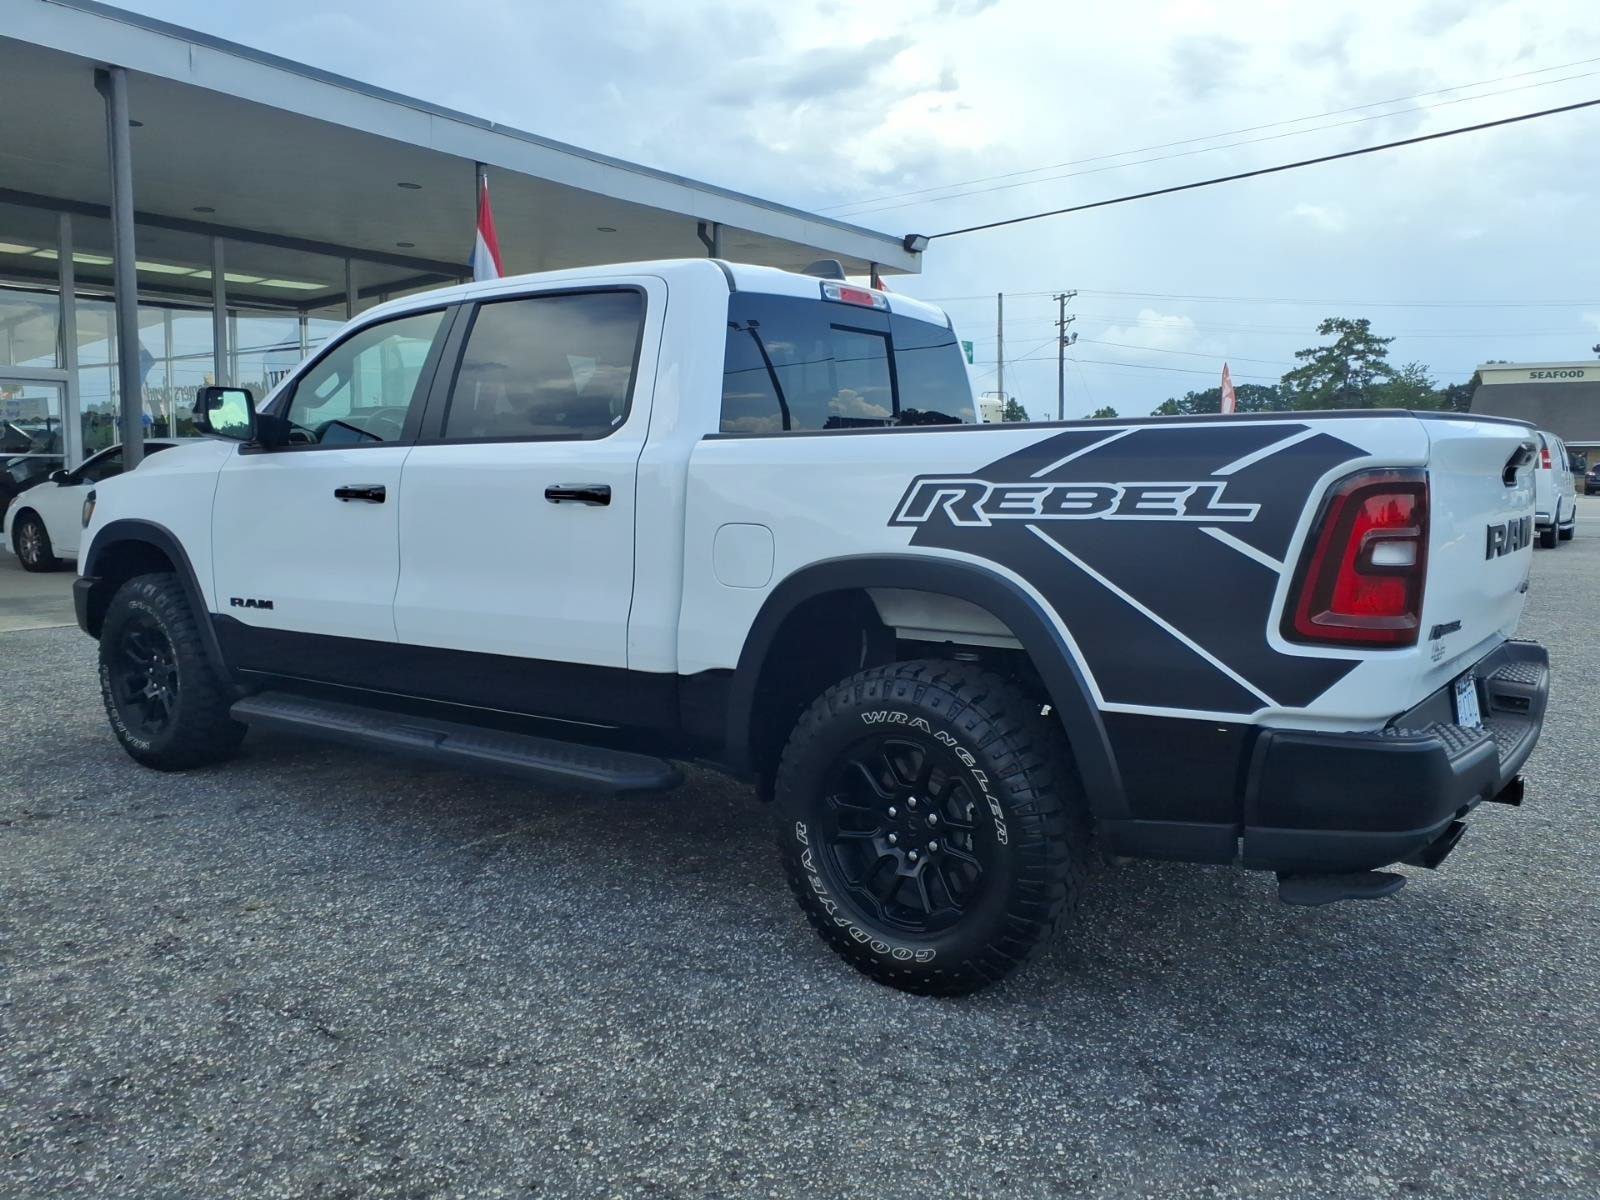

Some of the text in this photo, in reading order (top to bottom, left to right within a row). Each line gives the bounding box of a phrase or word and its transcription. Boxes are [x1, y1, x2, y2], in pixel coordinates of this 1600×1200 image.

[1529, 370, 1585, 380] SEAFOOD
[888, 475, 1262, 527] REBEL
[1485, 514, 1532, 560] RAM
[230, 597, 274, 610] RAM
[861, 710, 1009, 845] WRANGLER
[795, 820, 937, 963] GOODYEAR
